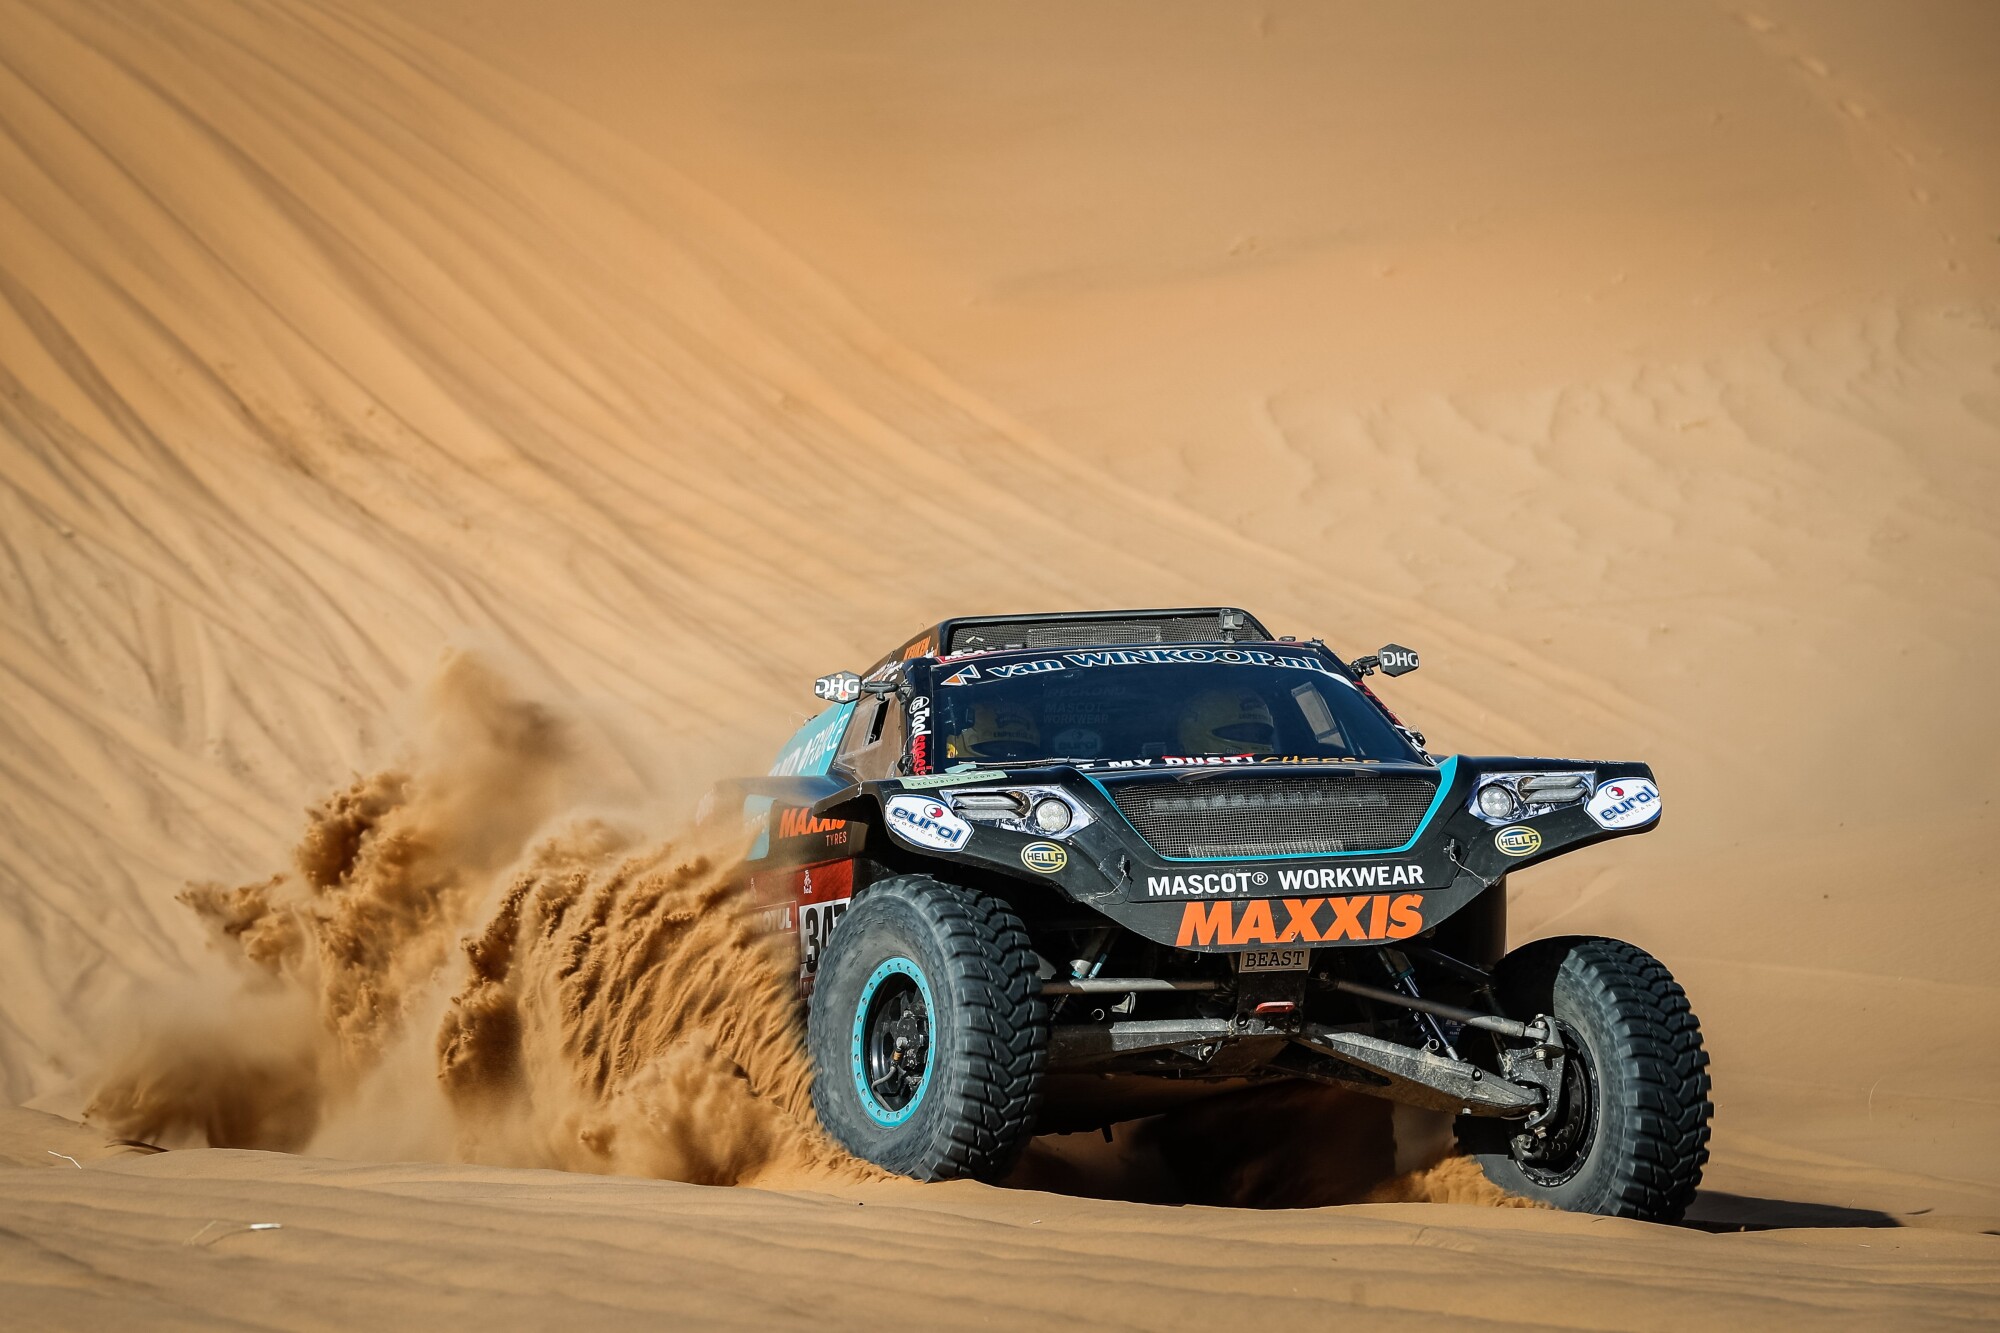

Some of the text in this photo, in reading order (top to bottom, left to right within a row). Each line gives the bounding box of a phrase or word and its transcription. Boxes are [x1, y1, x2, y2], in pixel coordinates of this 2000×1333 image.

[987, 648, 1328, 678] van WINKOOP.nl
[1383, 652, 1419, 667] DHG
[815, 678, 860, 695] DHG
[1045, 702, 1104, 713] MASCOT
[1043, 713, 1109, 724] WORKWEAR
[912, 707, 933, 776] Toolspeci
[911, 777, 961, 787] EXCLUSIVE
[967, 773, 998, 781] DOORS
[1601, 785, 1657, 820] eurol
[892, 807, 963, 843] eurol
[826, 831, 847, 847] TYRES
[1501, 834, 1540, 846] HELLA
[1027, 852, 1065, 863] HELLA
[1278, 864, 1425, 891] WORKWEAR
[1176, 893, 1424, 947] MAXXIS
[806, 903, 847, 974] 34
[1245, 951, 1305, 968] BEAST
